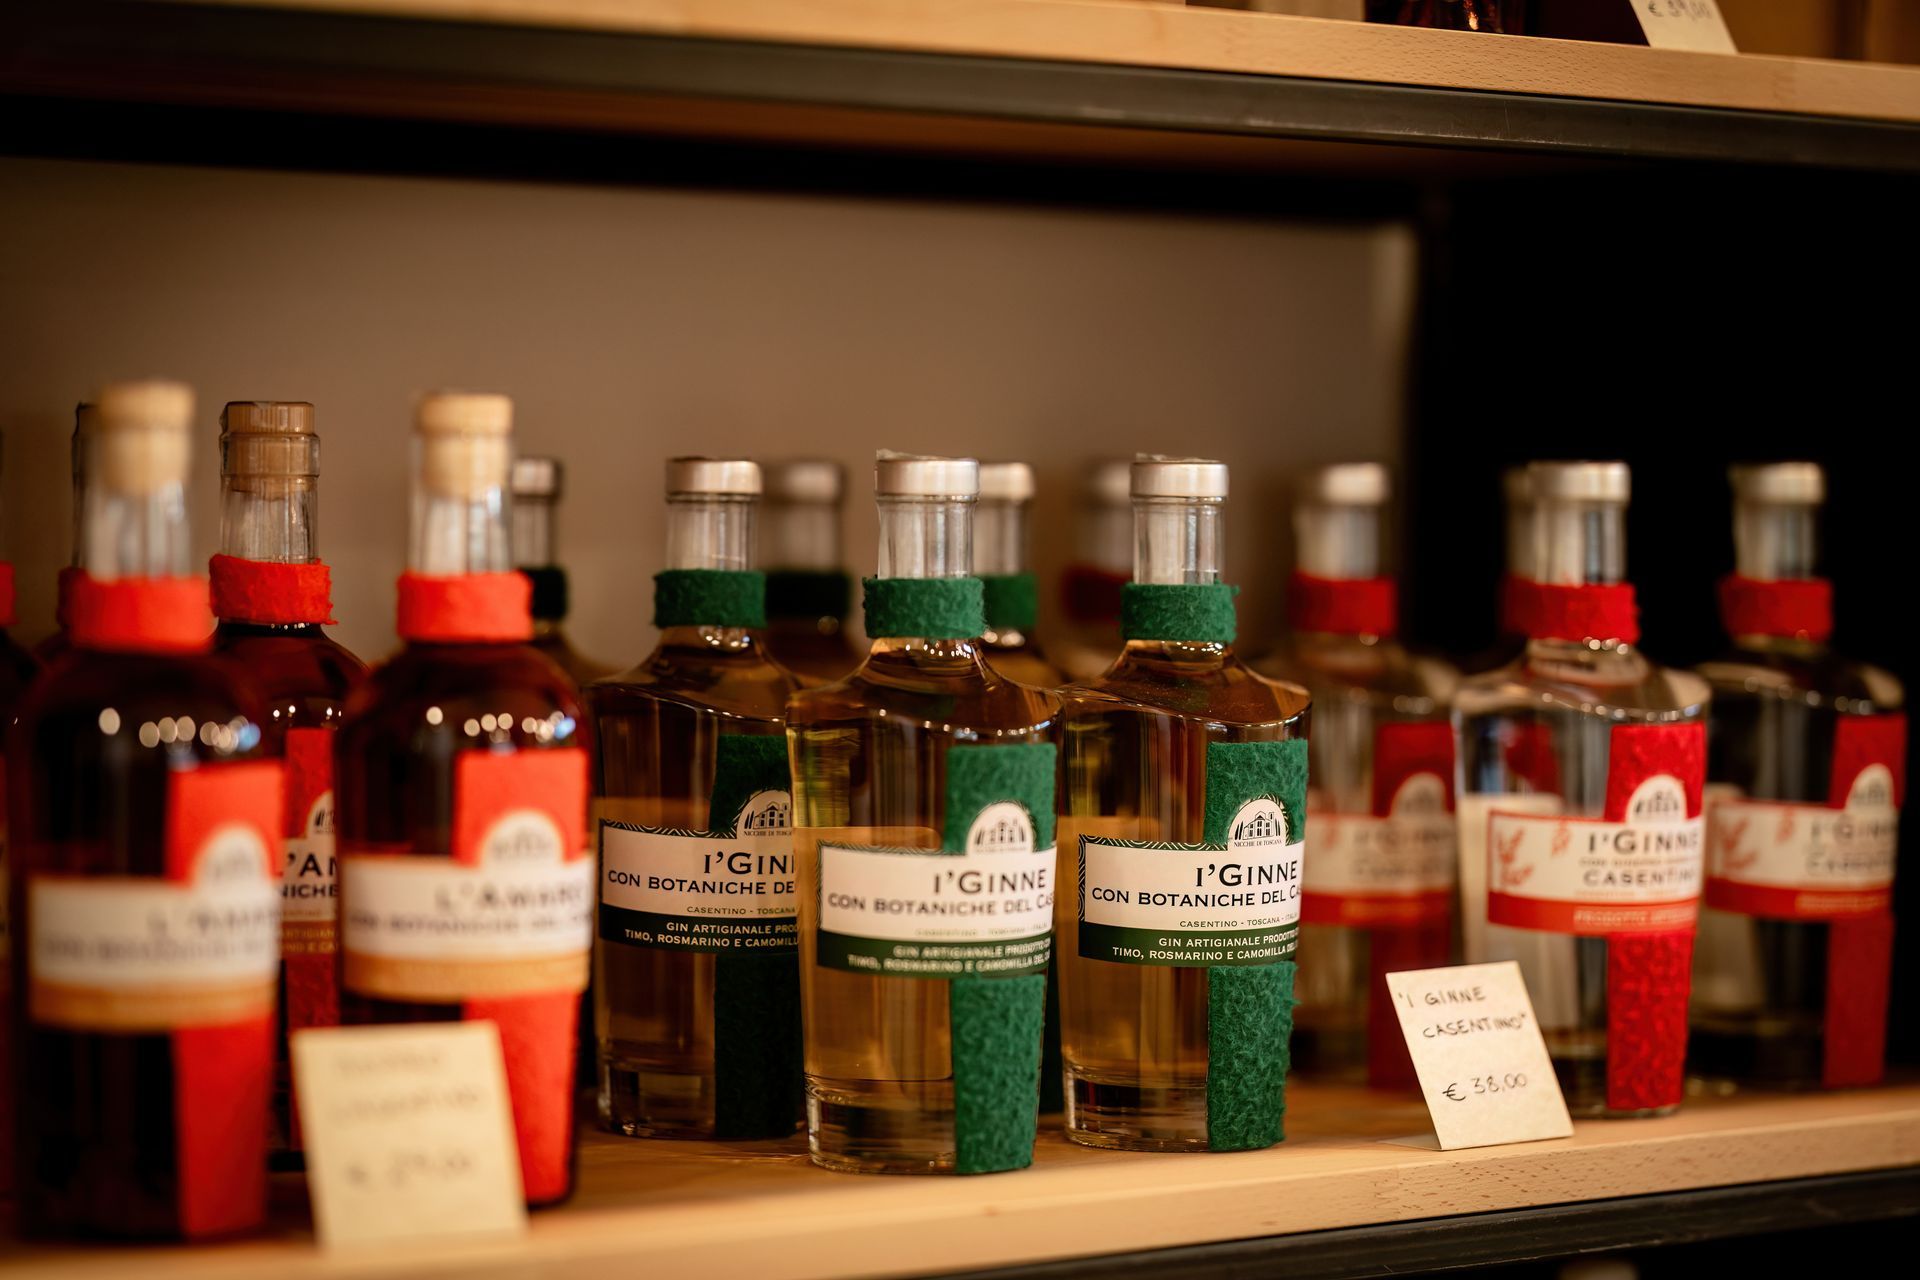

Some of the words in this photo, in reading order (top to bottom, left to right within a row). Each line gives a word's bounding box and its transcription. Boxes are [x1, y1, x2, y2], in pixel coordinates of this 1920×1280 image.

[703, 851, 795, 876] I'GIN
[1196, 859, 1298, 887] I'GINNE
[608, 869, 640, 887] CON
[648, 875, 766, 895] BOTANICHE
[933, 868, 1047, 895] I'GINNE
[827, 892, 866, 911] CON
[872, 898, 996, 917] BOTANICHE
[1004, 898, 1032, 915] DEL
[1091, 887, 1129, 904] CON
[1138, 891, 1255, 908] BOTANICHE
[1261, 889, 1286, 905] DEL
[687, 906, 747, 915] CASENTINO
[666, 922, 689, 932] GIN
[692, 924, 772, 934] ARTIGIANALE
[1179, 920, 1238, 928] CASENTINO
[1247, 916, 1280, 927] TOSCANA
[624, 928, 653, 943] TIMO,
[657, 933, 730, 947] ROSMARINO
[734, 938, 742, 947] E
[1158, 937, 1181, 947] GIN
[1186, 936, 1260, 948] ARTIGIANALE
[893, 945, 920, 958] GIN
[921, 945, 1003, 959] ARTIGIANALE
[1112, 947, 1144, 960] TIMO,
[1150, 950, 1223, 961] ROSMARINO
[1227, 951, 1234, 960] E
[1237, 945, 1287, 959] CAMOMILLA
[883, 958, 963, 973] ROSMARINO
[965, 959, 975, 972] E
[1424, 986, 1487, 1006] GINNE
[1441, 1083, 1467, 1102] €
[1470, 1072, 1528, 1095] 38,00
